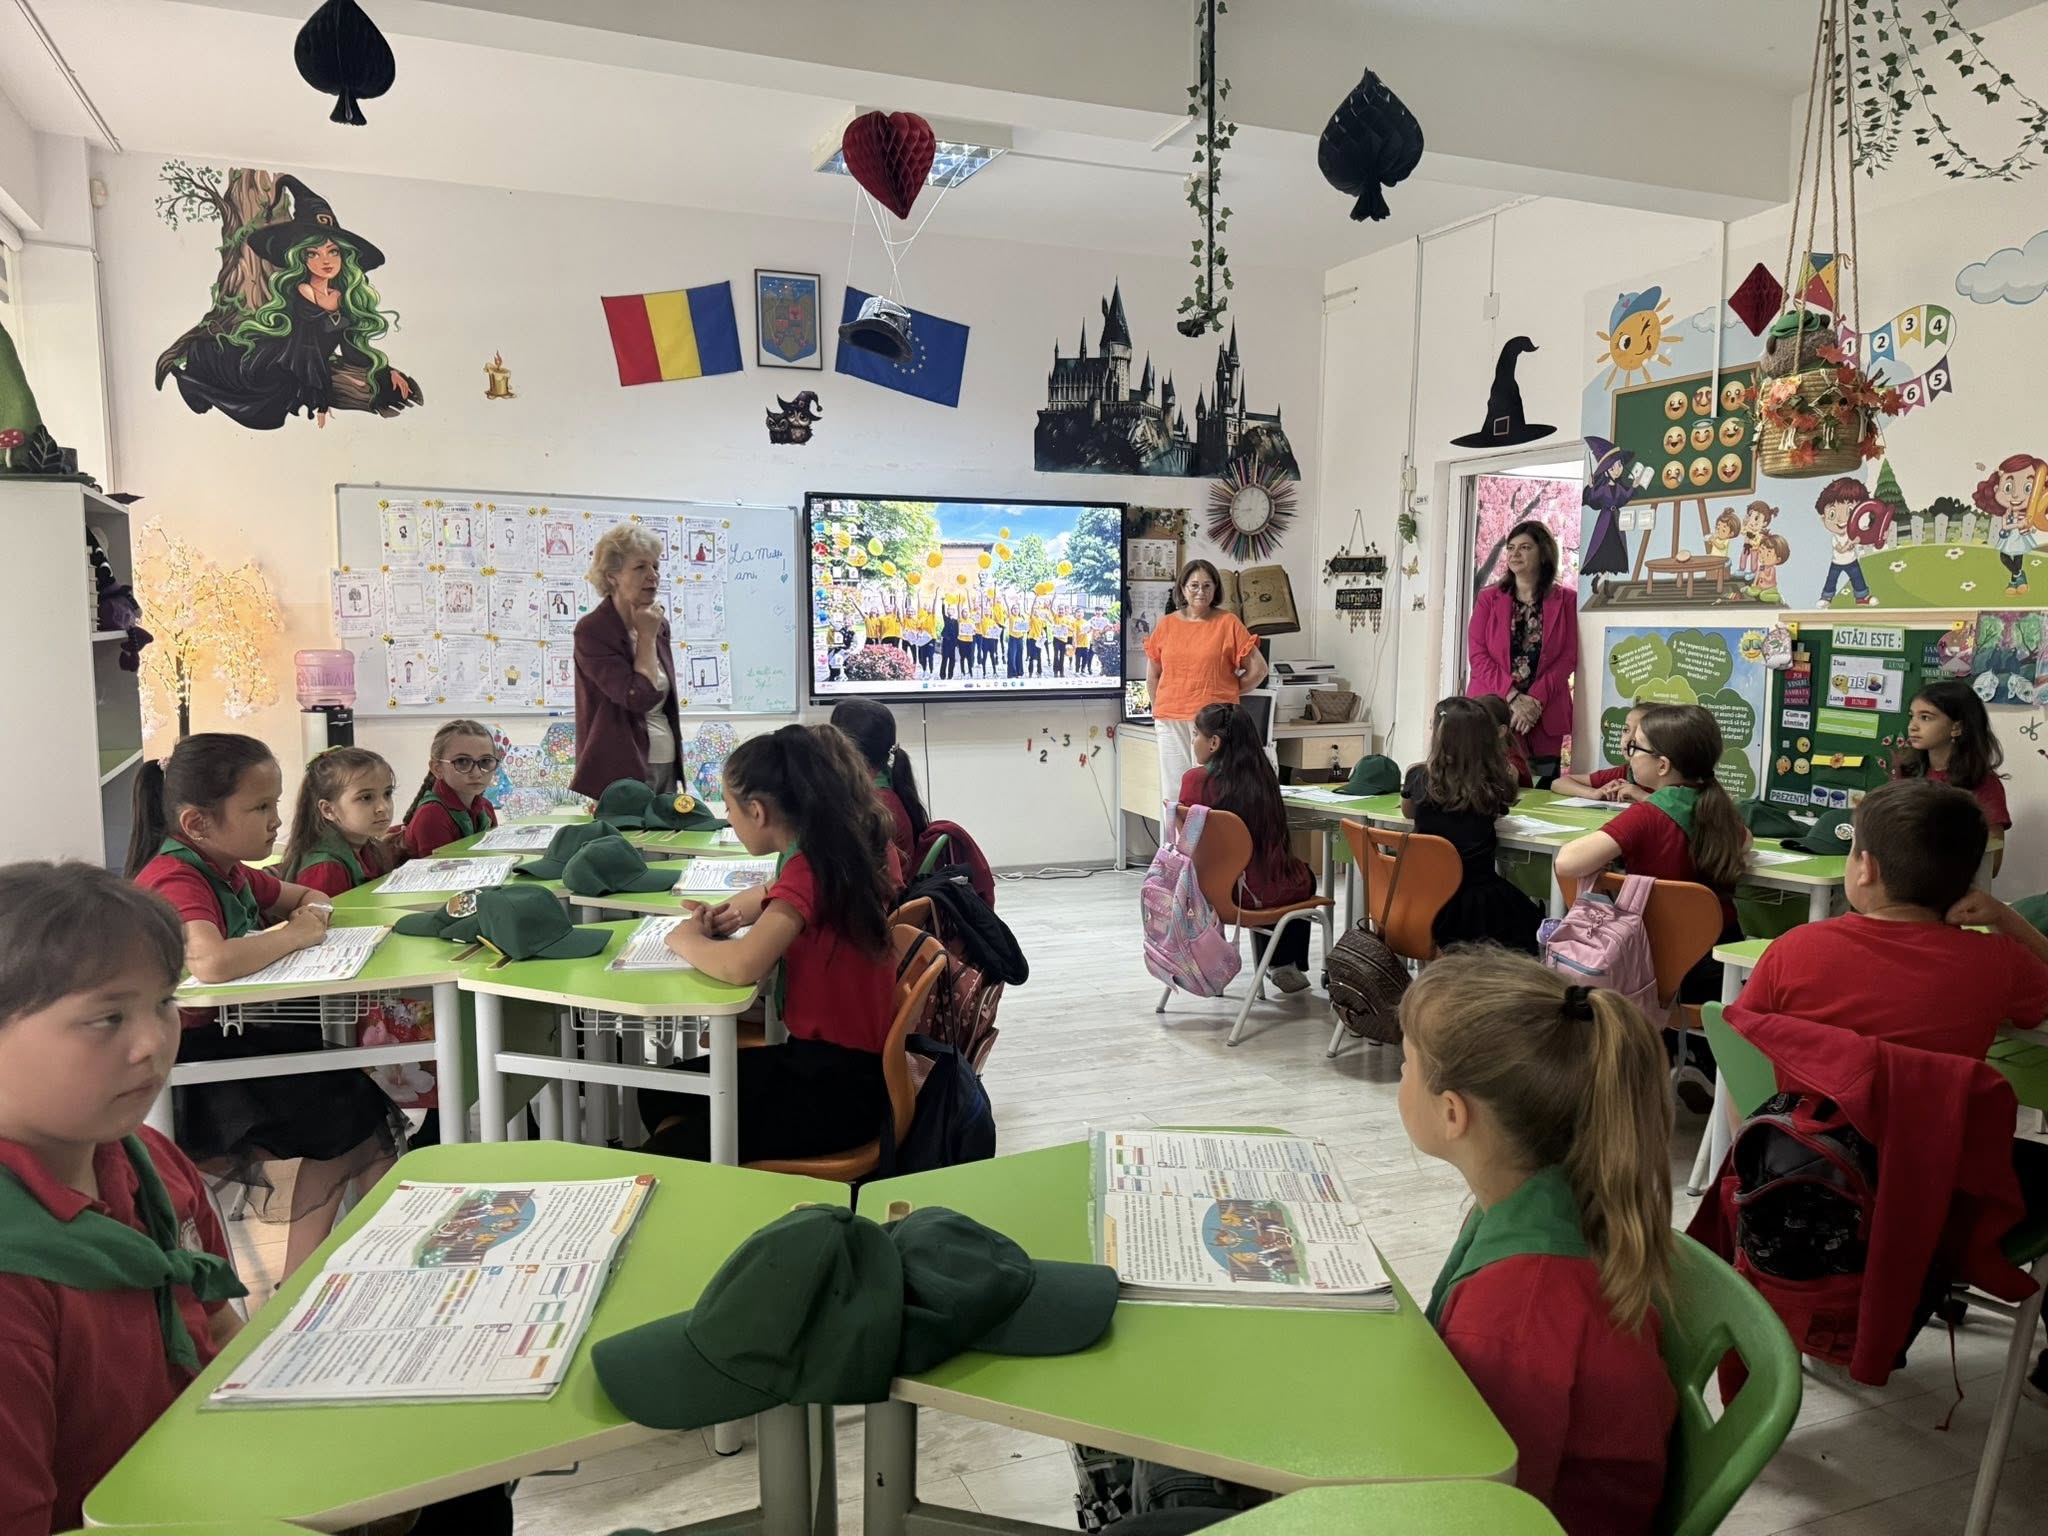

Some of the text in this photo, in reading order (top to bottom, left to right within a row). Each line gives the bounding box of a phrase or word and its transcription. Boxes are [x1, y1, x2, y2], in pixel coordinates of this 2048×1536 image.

[1906, 318, 1914, 330] 3
[1933, 319, 1942, 331] 4
[1846, 341, 1852, 353] 1
[1877, 337, 1885, 349] 2
[1933, 374, 1942, 386] 5
[1907, 388, 1915, 400] 6
[729, 543, 754, 564] La
[1835, 629, 1868, 646] ASTĂZI
[1870, 633, 1895, 647] ESTE
[1106, 726, 1114, 738] 8
[1027, 738, 1032, 751] 1
[1063, 734, 1070, 747] 3
[1040, 750, 1047, 762] 2
[1091, 745, 1101, 757] 7
[1079, 754, 1087, 767] 4
